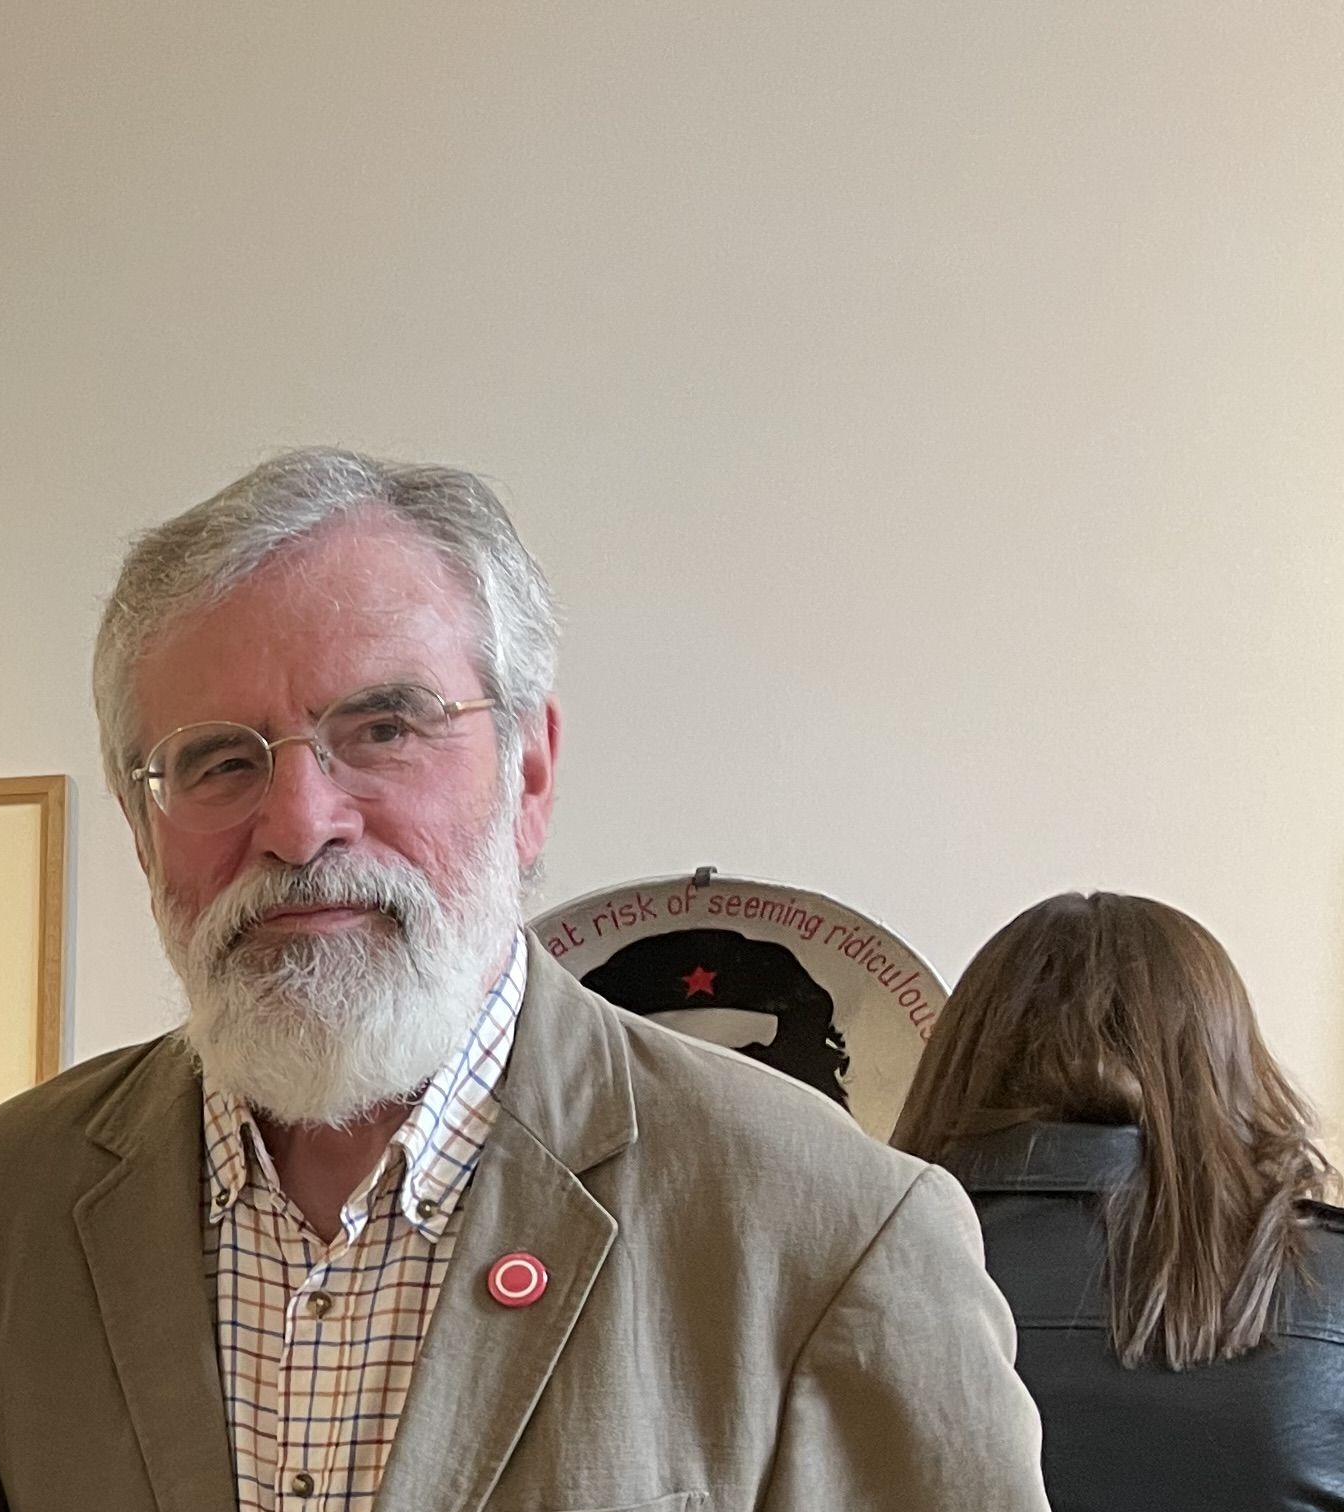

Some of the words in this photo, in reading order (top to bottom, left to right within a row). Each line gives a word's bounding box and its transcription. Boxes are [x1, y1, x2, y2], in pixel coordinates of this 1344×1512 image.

[548, 921, 584, 958] at
[592, 892, 657, 936] risk
[667, 883, 698, 916] of
[708, 895, 825, 940] seeming
